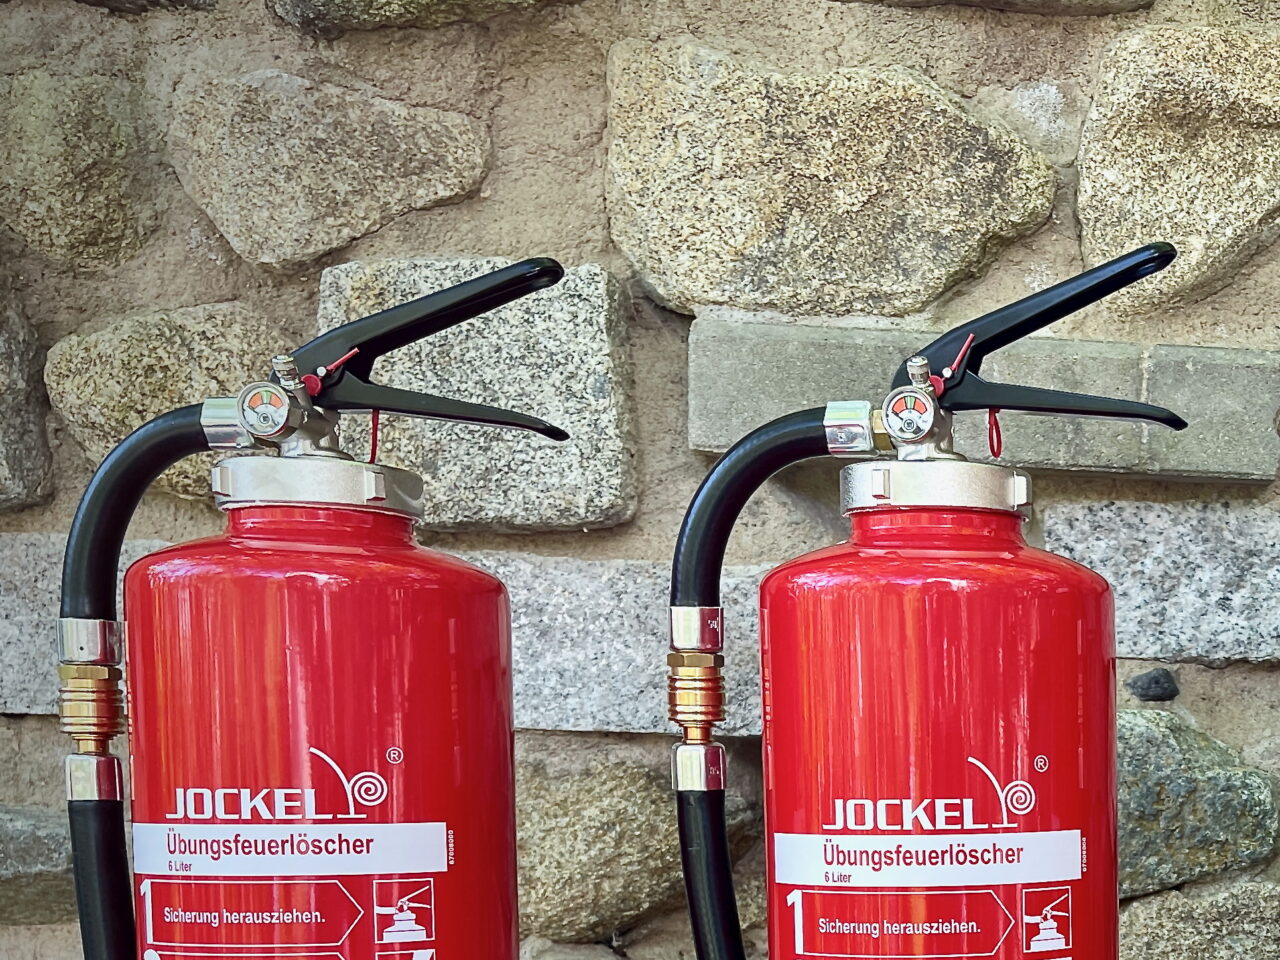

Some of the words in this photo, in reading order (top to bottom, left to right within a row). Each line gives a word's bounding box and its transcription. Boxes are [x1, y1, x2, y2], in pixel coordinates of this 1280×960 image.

[166, 787, 333, 819] JOCKEL
[823, 798, 988, 830] JOCKEL
[168, 828, 374, 861] Übungsfeuerlöscher
[824, 839, 1023, 872] Übungsfeuerlöscher
[168, 860, 173, 872] 6
[175, 861, 192, 872] Liter
[824, 871, 830, 883] 6
[832, 872, 852, 882] Liter
[140, 879, 155, 944] 1
[165, 907, 219, 927] Sicherung
[223, 907, 325, 923] herausziehen.
[787, 889, 805, 954] 1
[819, 918, 879, 938] Sicherung
[884, 919, 980, 934] herausziehen.
